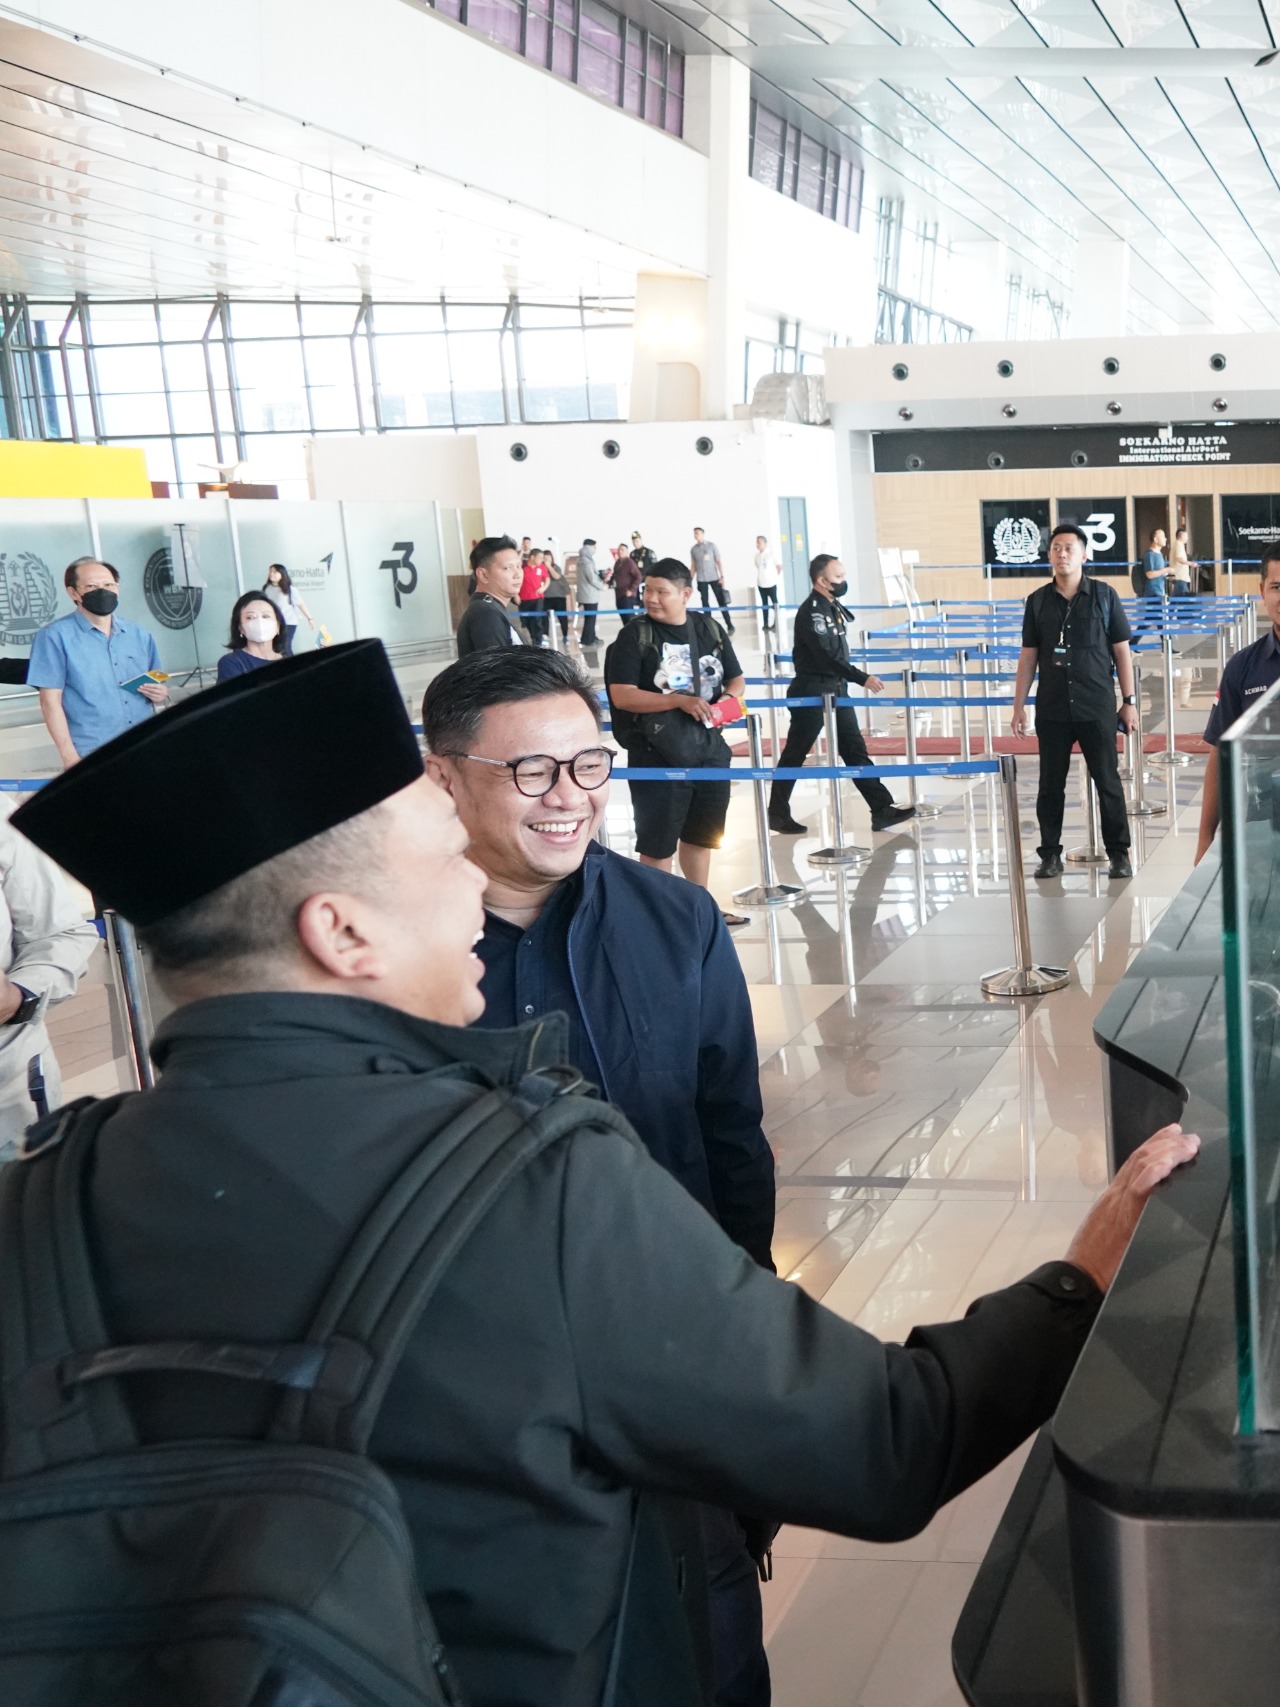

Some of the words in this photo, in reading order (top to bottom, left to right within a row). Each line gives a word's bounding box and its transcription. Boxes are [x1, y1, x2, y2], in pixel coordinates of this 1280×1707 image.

[1119, 436, 1185, 446] SOEKARNO
[1188, 435, 1228, 445] HATTA
[1129, 445, 1184, 454] International
[1119, 454, 1175, 463] IMMIGRATION
[1175, 453, 1204, 461] CHECK
[1205, 452, 1231, 461] POINT
